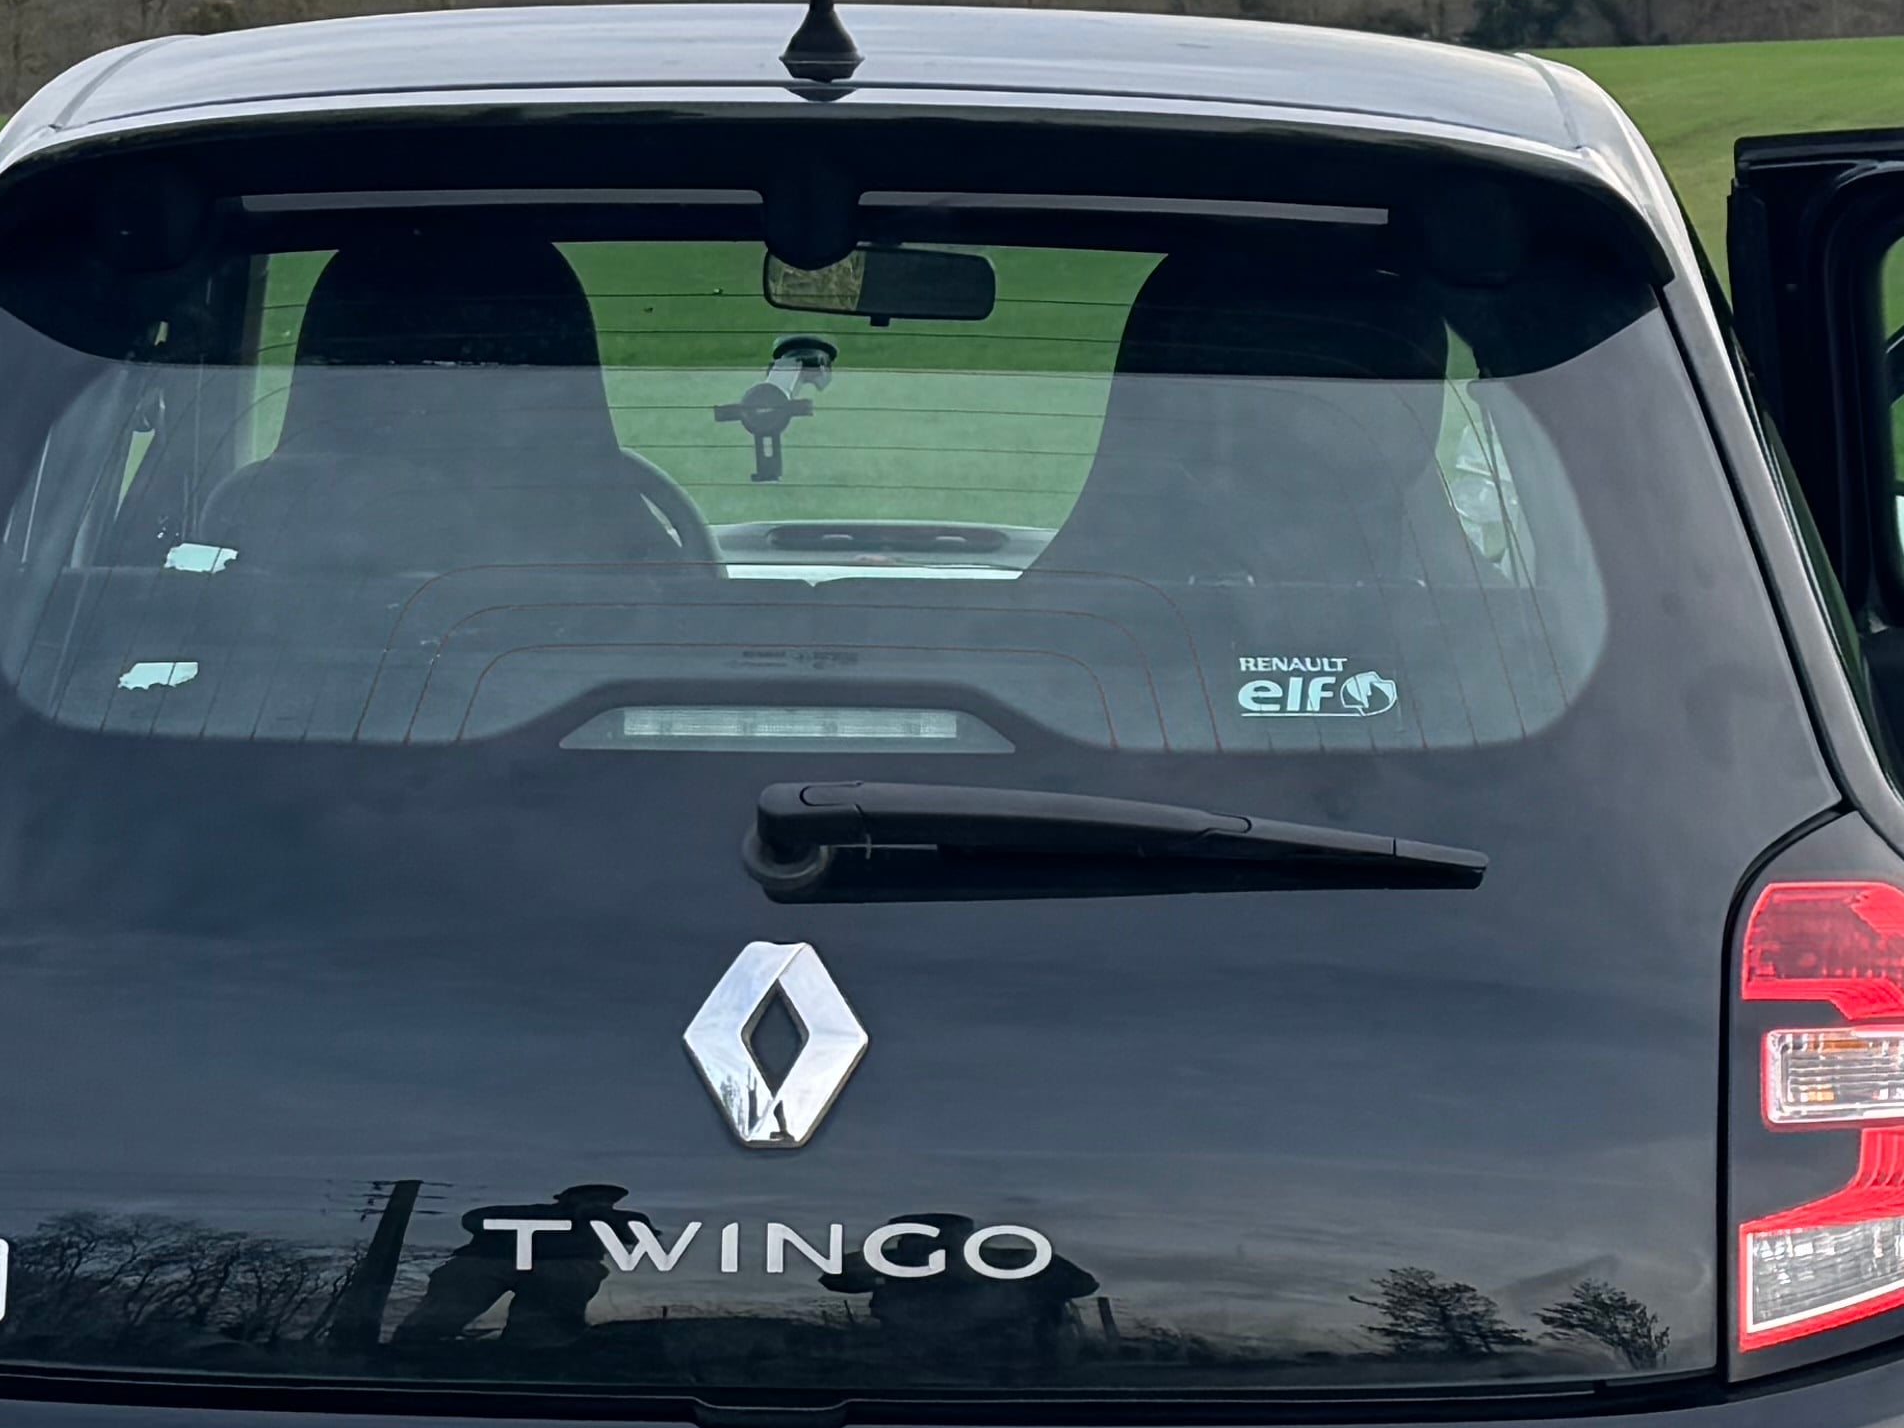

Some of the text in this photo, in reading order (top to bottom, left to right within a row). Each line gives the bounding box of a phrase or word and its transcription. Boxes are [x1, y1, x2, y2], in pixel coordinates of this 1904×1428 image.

[1239, 657, 1347, 671] RENAULT
[1238, 676, 1336, 712] elf
[483, 1218, 1053, 1279] TWINGO
